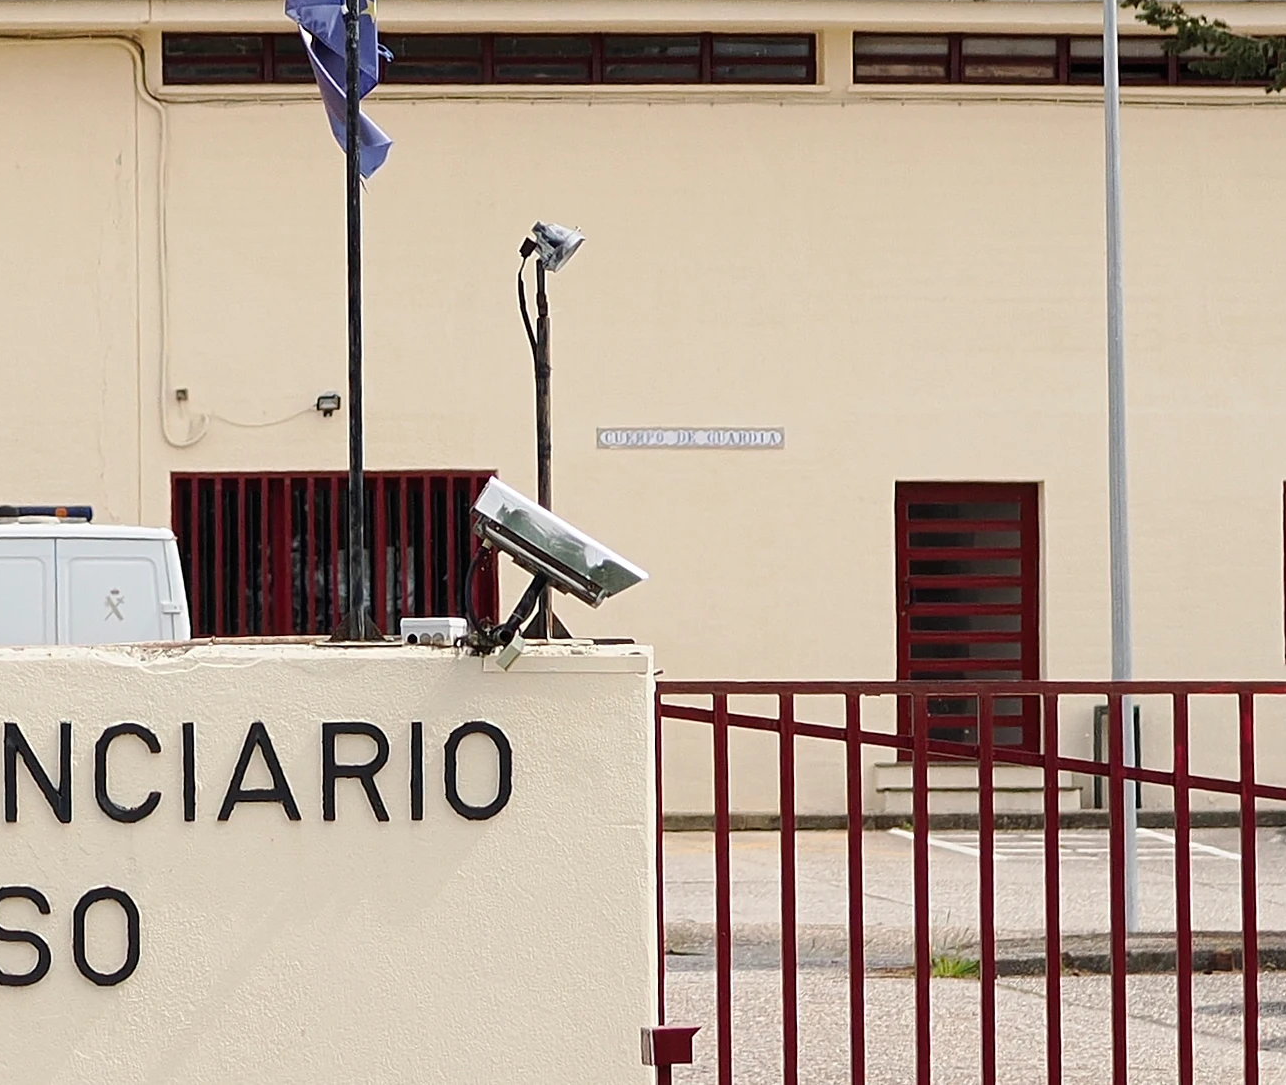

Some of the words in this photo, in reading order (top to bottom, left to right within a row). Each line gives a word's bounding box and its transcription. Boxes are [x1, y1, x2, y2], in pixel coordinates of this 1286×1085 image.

[605, 430, 665, 443] CUERPO
[676, 430, 696, 443] DE
[707, 430, 777, 443] GUARDIA
